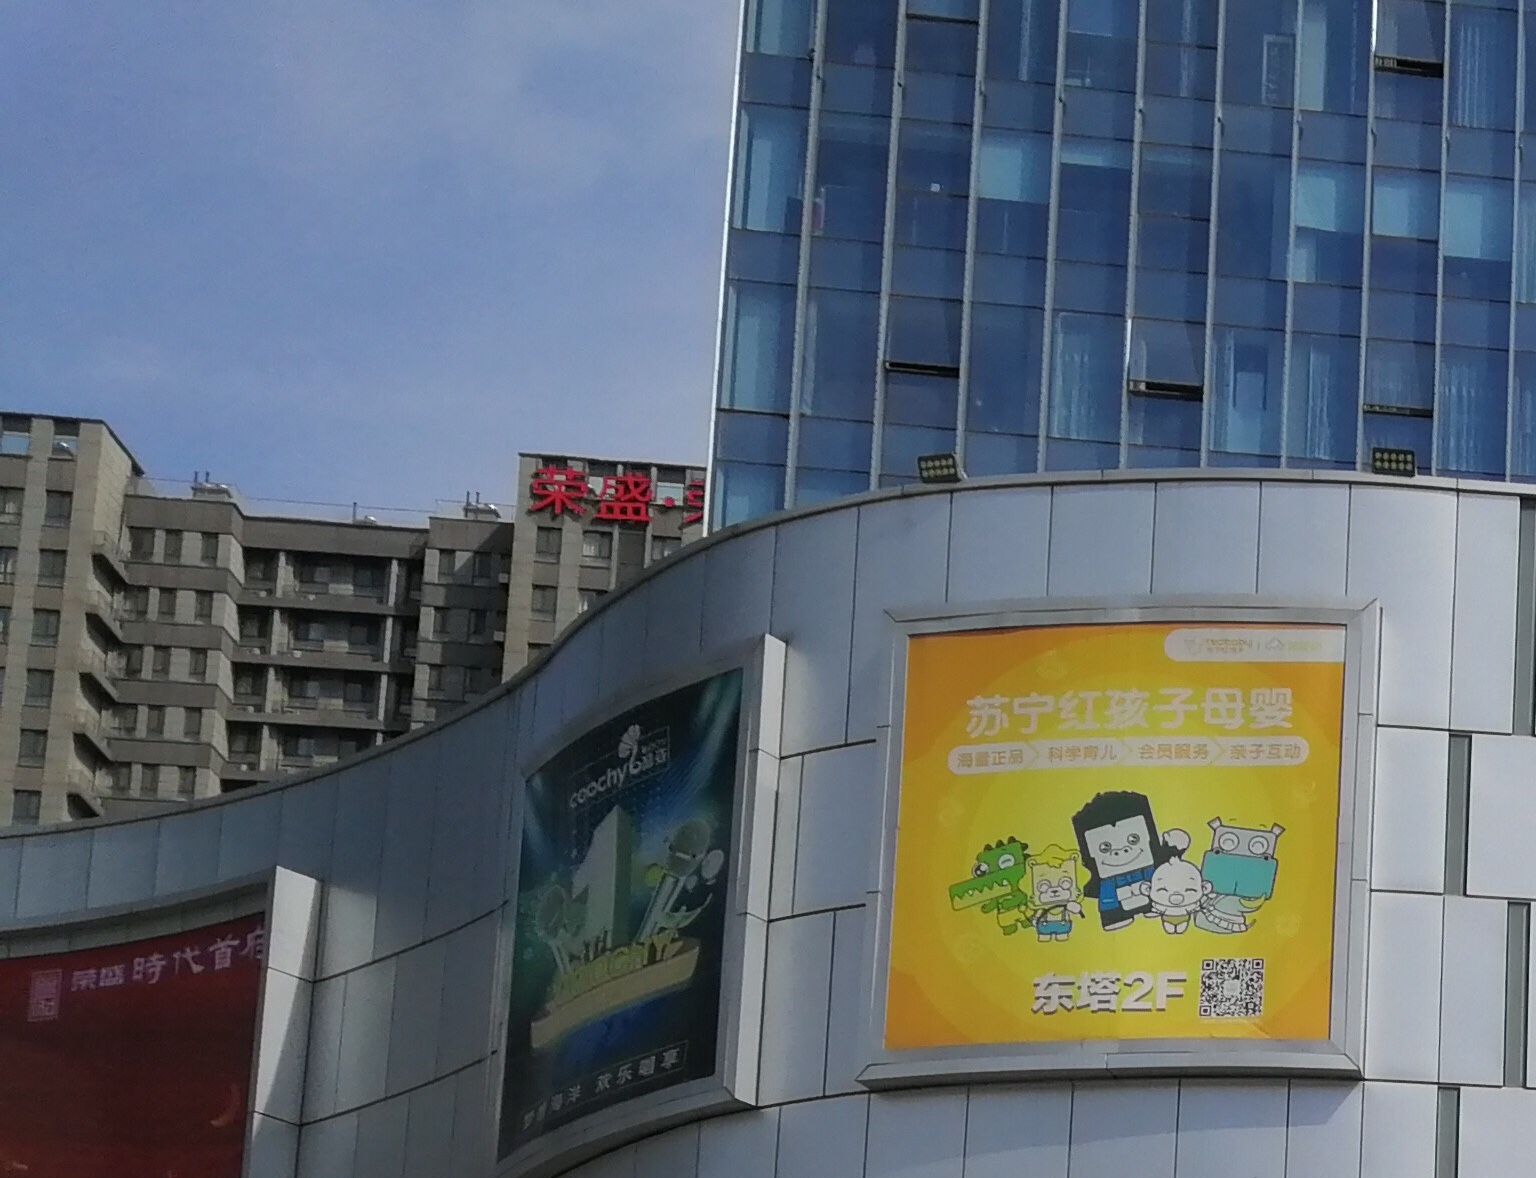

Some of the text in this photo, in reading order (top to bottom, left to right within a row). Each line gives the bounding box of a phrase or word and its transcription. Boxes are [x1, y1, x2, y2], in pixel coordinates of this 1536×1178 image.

[965, 687, 1293, 738] 苏宁红孩子母婴
[1047, 744, 1118, 763] 科学育儿
[1137, 742, 1210, 761] 会员服务
[1229, 742, 1302, 761] 亲子互动
[1031, 971, 1188, 1016] 东塔2F
